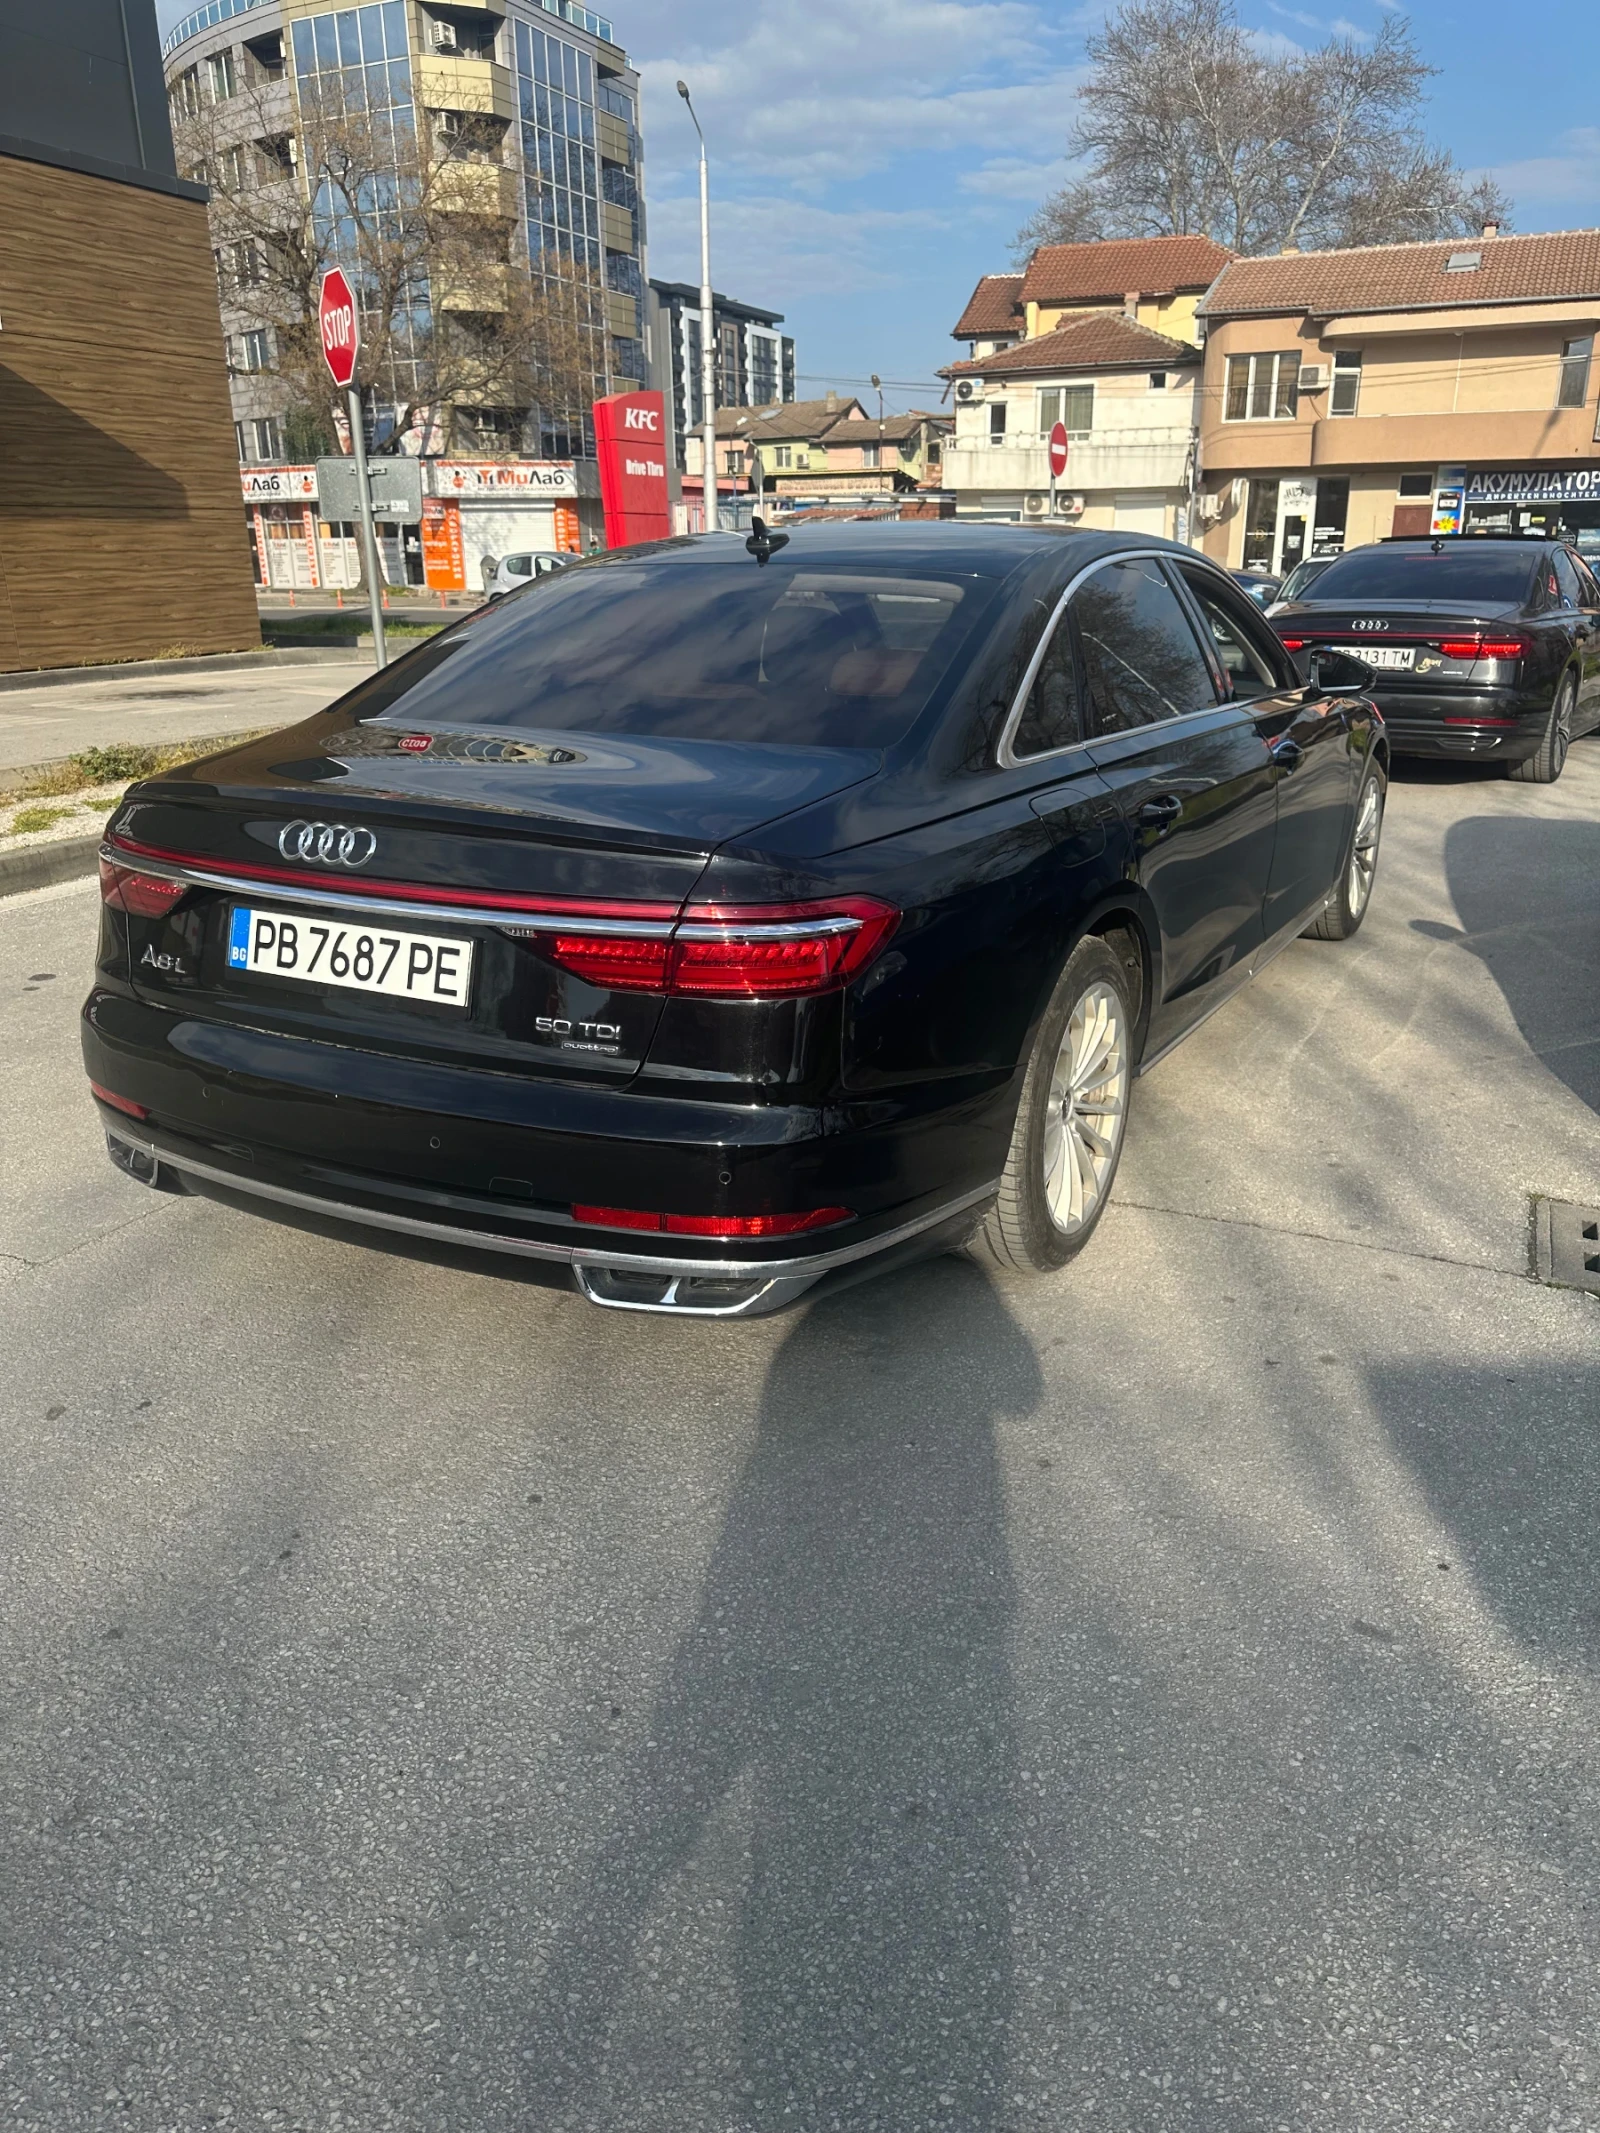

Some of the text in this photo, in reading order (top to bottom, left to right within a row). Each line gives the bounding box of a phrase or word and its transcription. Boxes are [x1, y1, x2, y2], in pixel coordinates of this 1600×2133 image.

[324, 304, 351, 351] STOP
[624, 407, 659, 431] KFC
[626, 459, 664, 477] Drive Thru
[243, 475, 280, 491] иЛаб
[1485, 491, 1597, 501] ДИРЕКТЕН ВНОСИТЕЛ
[1393, 650, 1411, 666] TM
[232, 946, 247, 962] BG
[253, 918, 461, 997] PB 7687 PE
[535, 1016, 621, 1040] 50 TDI
[563, 1042, 617, 1053] quattro
